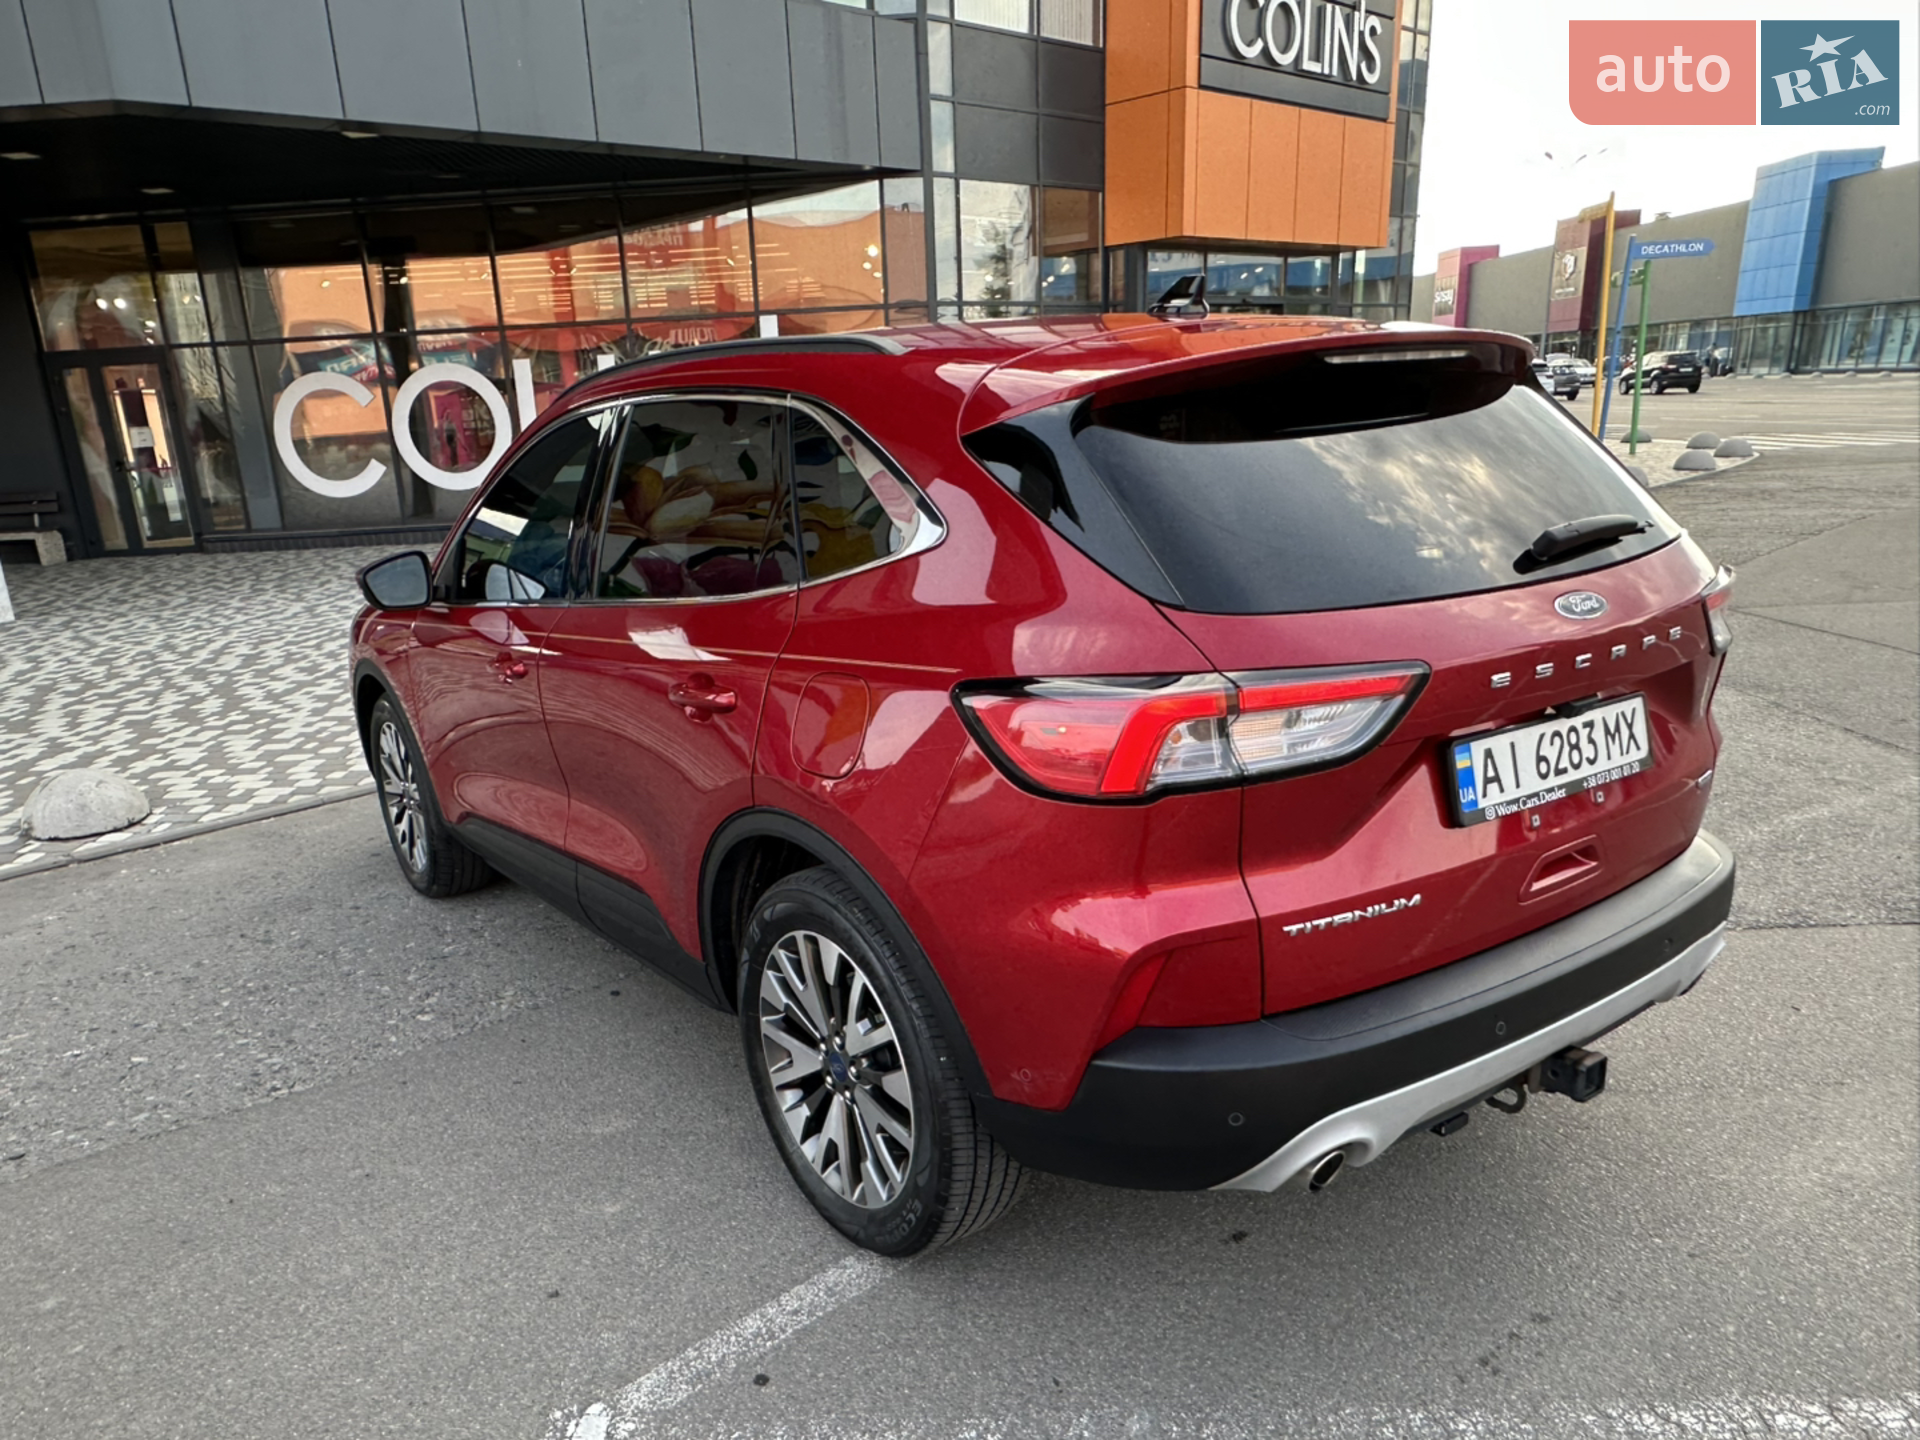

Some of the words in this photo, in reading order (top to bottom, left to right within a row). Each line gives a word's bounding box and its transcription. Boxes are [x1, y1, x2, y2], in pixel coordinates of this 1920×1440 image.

[1229, 0, 1382, 85] COLIN'S
[1641, 243, 1704, 255] DECATHLON
[1569, 593, 1600, 612] Ford
[1491, 626, 1682, 689] ESCAPE
[1482, 741, 1520, 799] AI
[1535, 719, 1598, 781] 6283
[1602, 706, 1641, 761] MX
[1459, 786, 1476, 804] UA
[1282, 893, 1421, 937] TITANIUM
